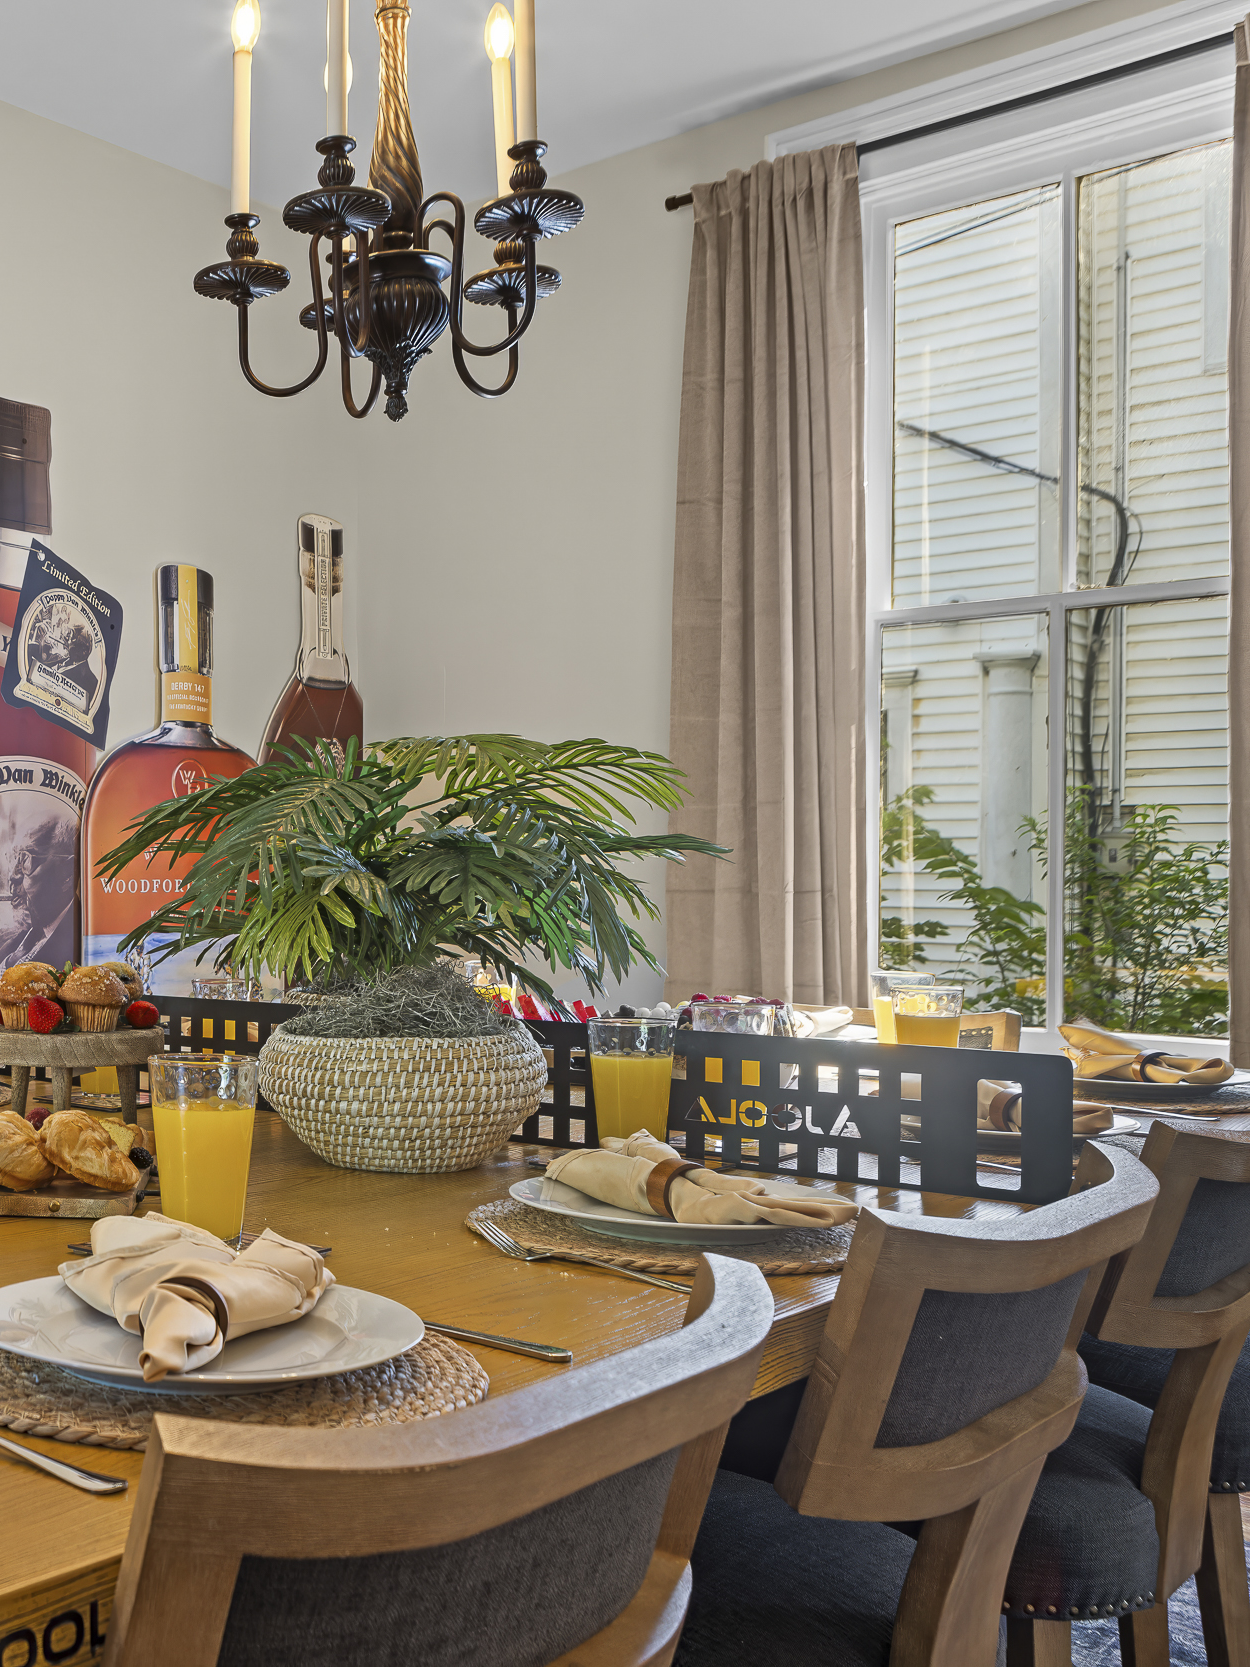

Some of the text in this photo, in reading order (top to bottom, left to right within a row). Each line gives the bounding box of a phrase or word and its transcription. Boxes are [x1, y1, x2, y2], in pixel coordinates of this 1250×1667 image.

[42, 560, 111, 618] Limited Edition
[100, 877, 191, 894] WOODFOR
